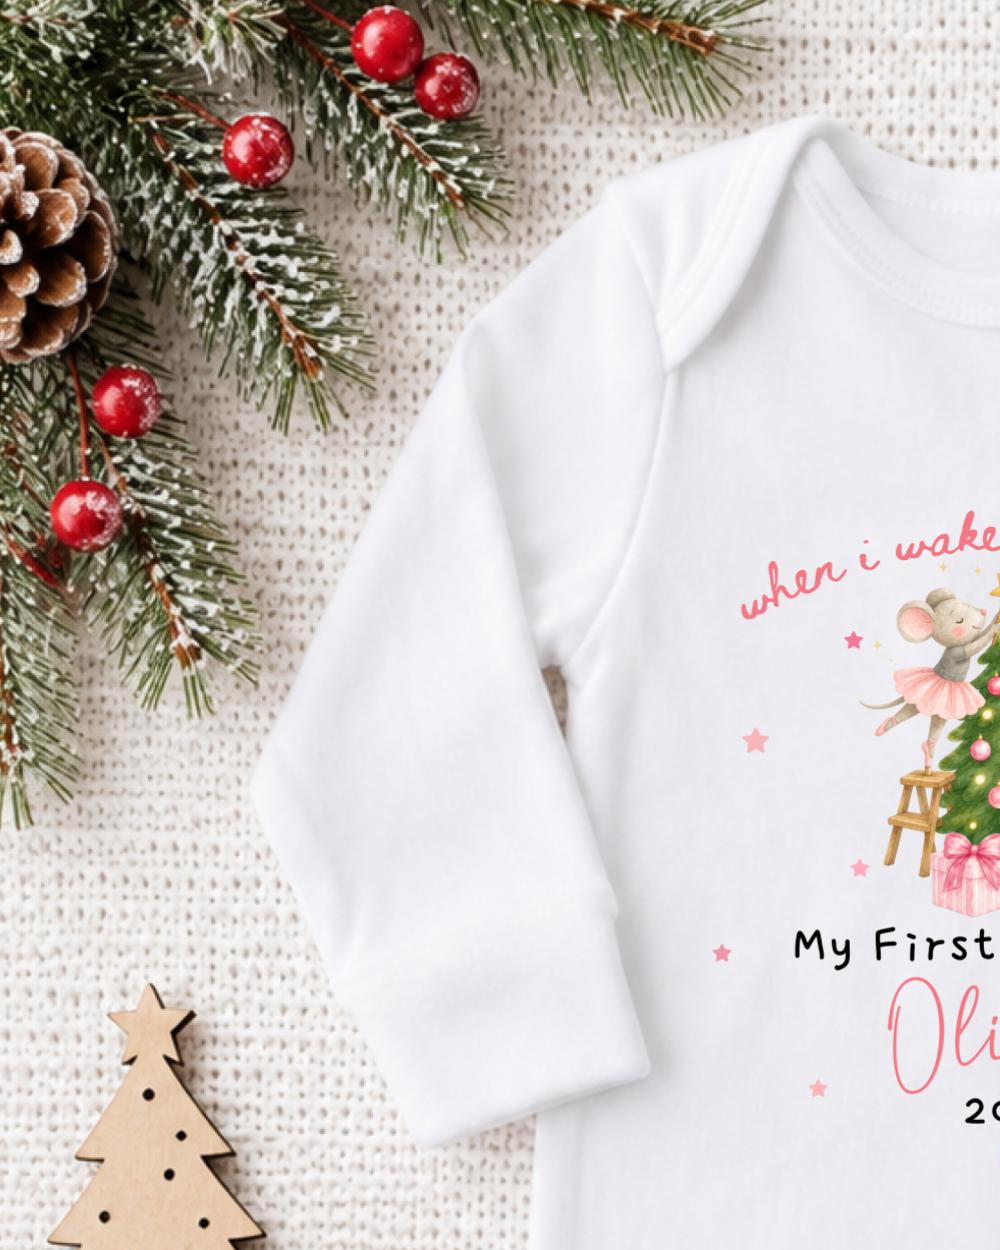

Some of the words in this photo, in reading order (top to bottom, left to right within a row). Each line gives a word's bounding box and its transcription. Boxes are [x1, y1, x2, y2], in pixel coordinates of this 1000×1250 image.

[740, 560, 847, 621] when
[858, 538, 881, 571] i
[794, 929, 851, 971] My
[875, 926, 995, 962] First
